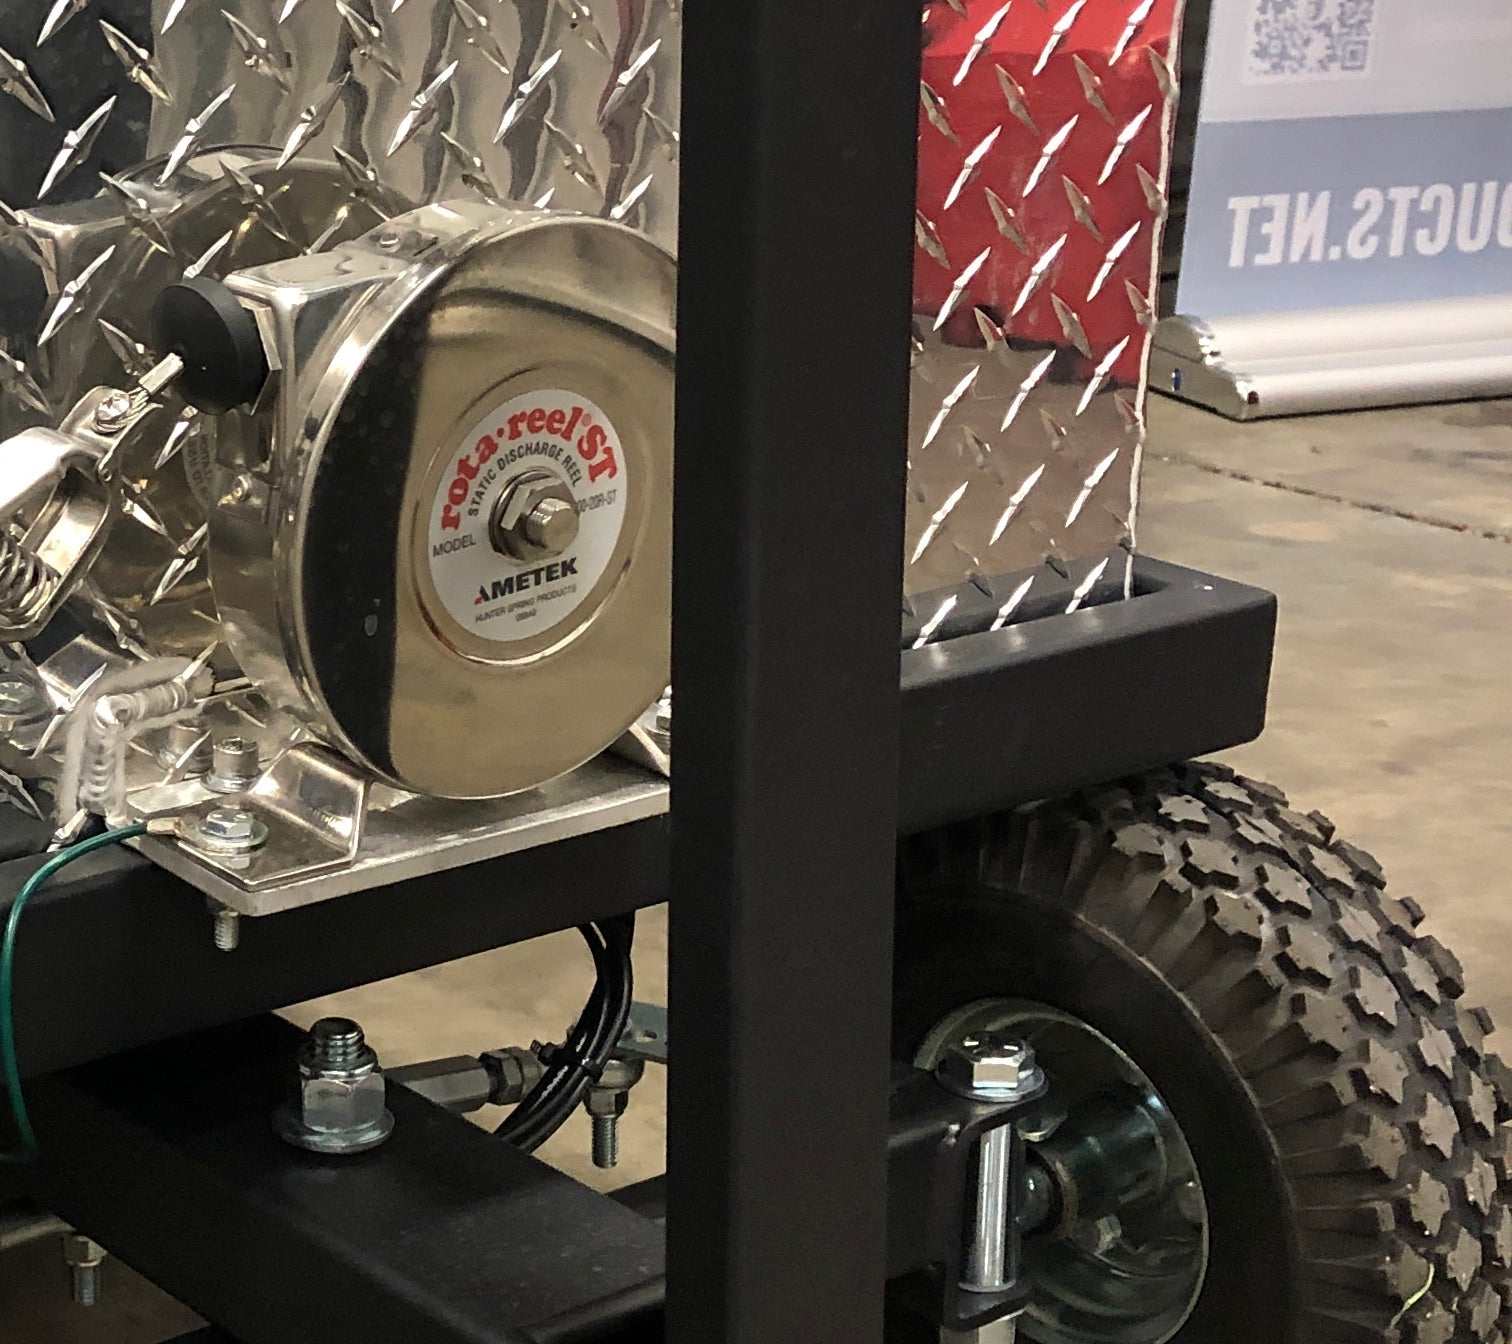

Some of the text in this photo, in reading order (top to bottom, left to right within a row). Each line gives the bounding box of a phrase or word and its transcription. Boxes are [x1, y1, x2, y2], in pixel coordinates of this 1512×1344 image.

[577, 422, 618, 483] ST
[468, 441, 582, 516] STATIC DISCHARGE REEL
[433, 534, 476, 557] MODEL
[474, 557, 578, 605] AMETEK
[537, 584, 577, 603] PRODUCTS
